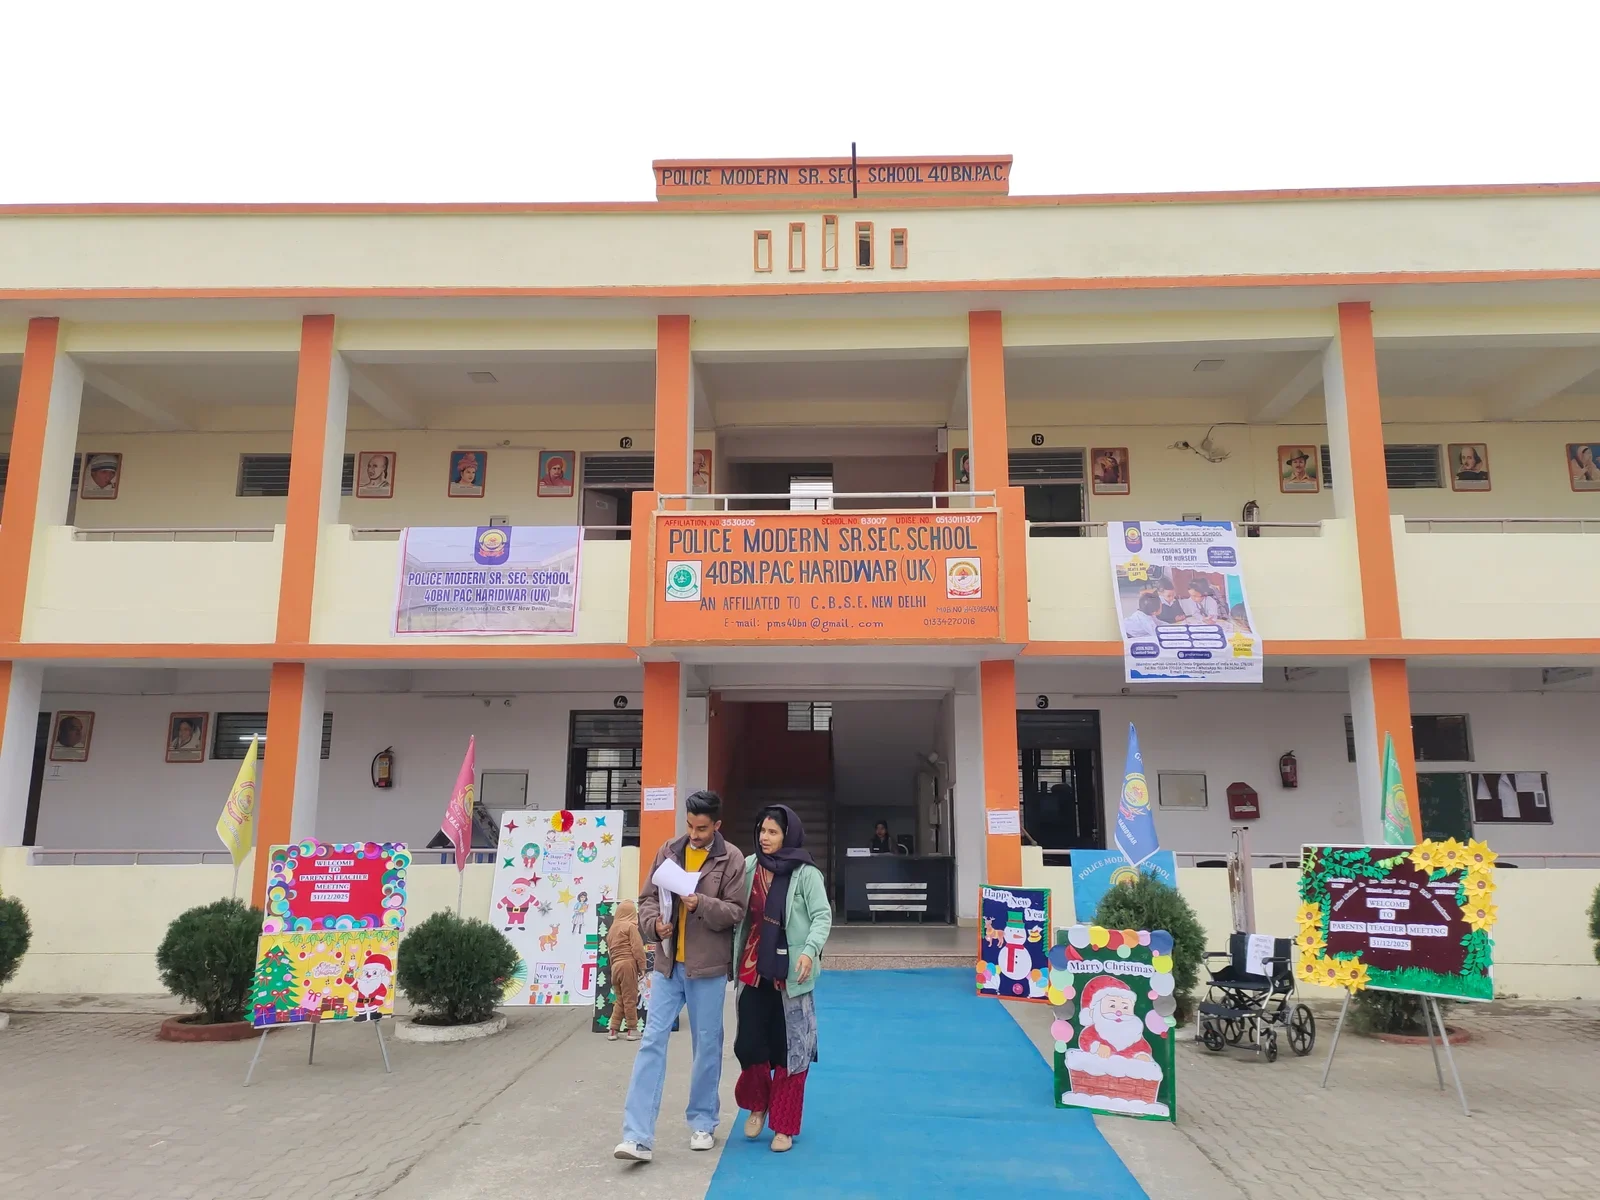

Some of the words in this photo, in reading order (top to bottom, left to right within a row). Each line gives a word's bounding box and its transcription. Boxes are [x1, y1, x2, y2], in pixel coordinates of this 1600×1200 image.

[662, 169, 712, 186] POLICE
[720, 168, 789, 185] MODERN
[798, 168, 823, 184] SR.
[868, 166, 923, 183] SCHOOL
[720, 518, 756, 527] 3530205
[860, 517, 887, 525] 83007
[669, 528, 732, 554] POLICE
[743, 527, 829, 554] MODERN
[799, 559, 897, 585] HARIDWAR
[900, 554, 937, 586] (UK)
[408, 573, 443, 586] POLICE
[444, 572, 486, 585] MODERN
[488, 572, 505, 585] SR.
[508, 572, 529, 585] SEC.
[532, 571, 571, 585] SCHOOL
[424, 589, 450, 602] 40BN
[453, 589, 473, 602] PAC
[475, 588, 528, 602] HARIDWAR
[530, 588, 551, 602] (UK)
[700, 596, 716, 611] AN
[723, 596, 780, 611] AFFILIATED
[787, 596, 800, 610] TO
[872, 595, 893, 608] NEW
[898, 595, 926, 608] DELHI
[724, 618, 760, 627] E-mail:
[1079, 859, 1105, 880] POLICE
[1141, 860, 1170, 881] SCHOOL
[984, 888, 1011, 900] Happy
[1011, 897, 1029, 906] New
[1369, 900, 1407, 908] WELCOME
[1369, 924, 1404, 932] TEACHER
[1372, 940, 1409, 948] 31/12/2025
[1069, 962, 1101, 973] Marry
[1104, 961, 1153, 973] Christmas
